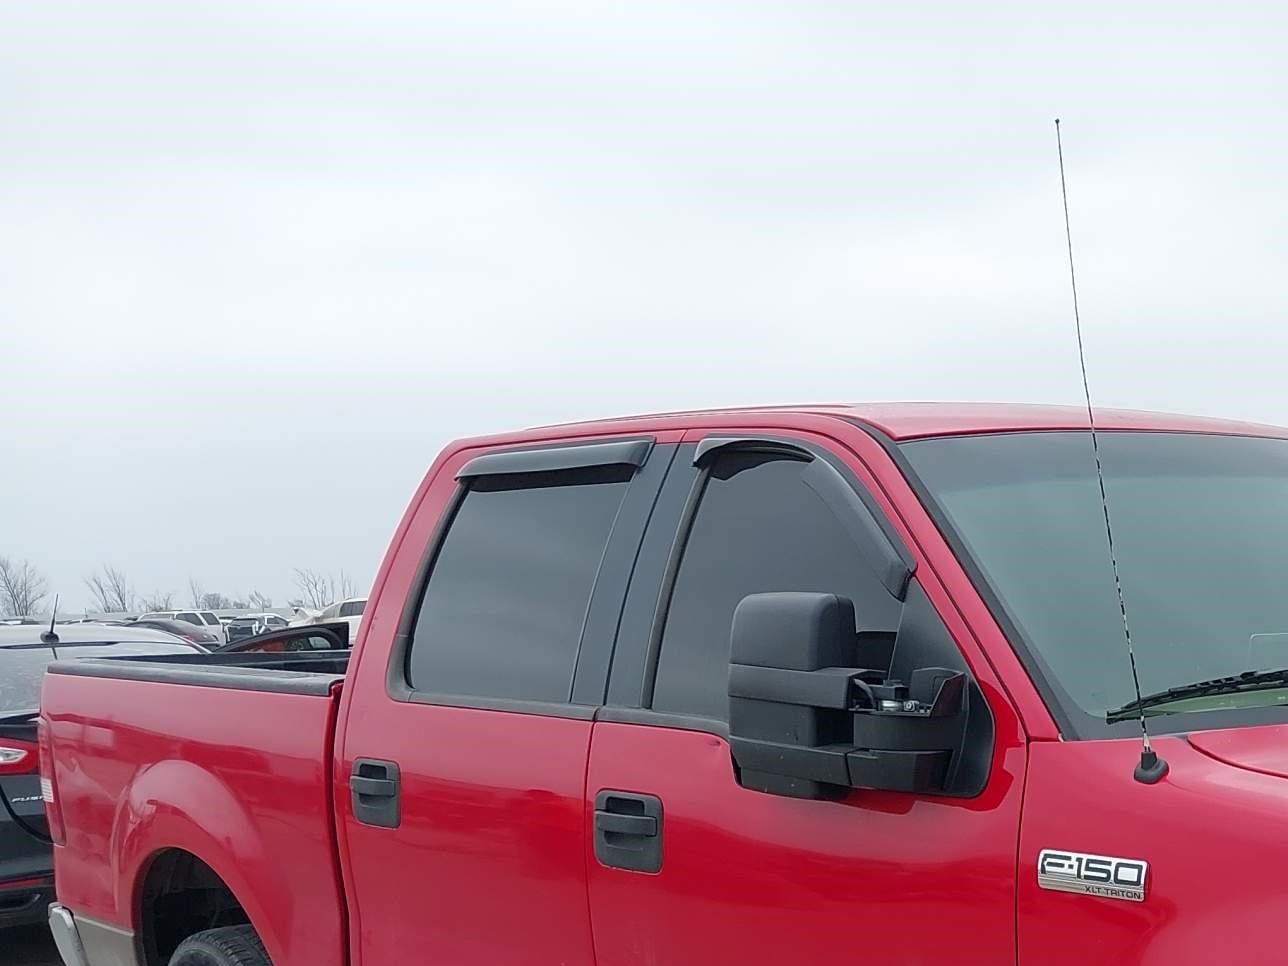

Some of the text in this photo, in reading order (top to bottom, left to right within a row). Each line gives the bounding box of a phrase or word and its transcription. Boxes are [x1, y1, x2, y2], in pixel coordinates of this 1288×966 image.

[1040, 853, 1144, 887] F-150
[1084, 885, 1142, 900] XLT TRITON
